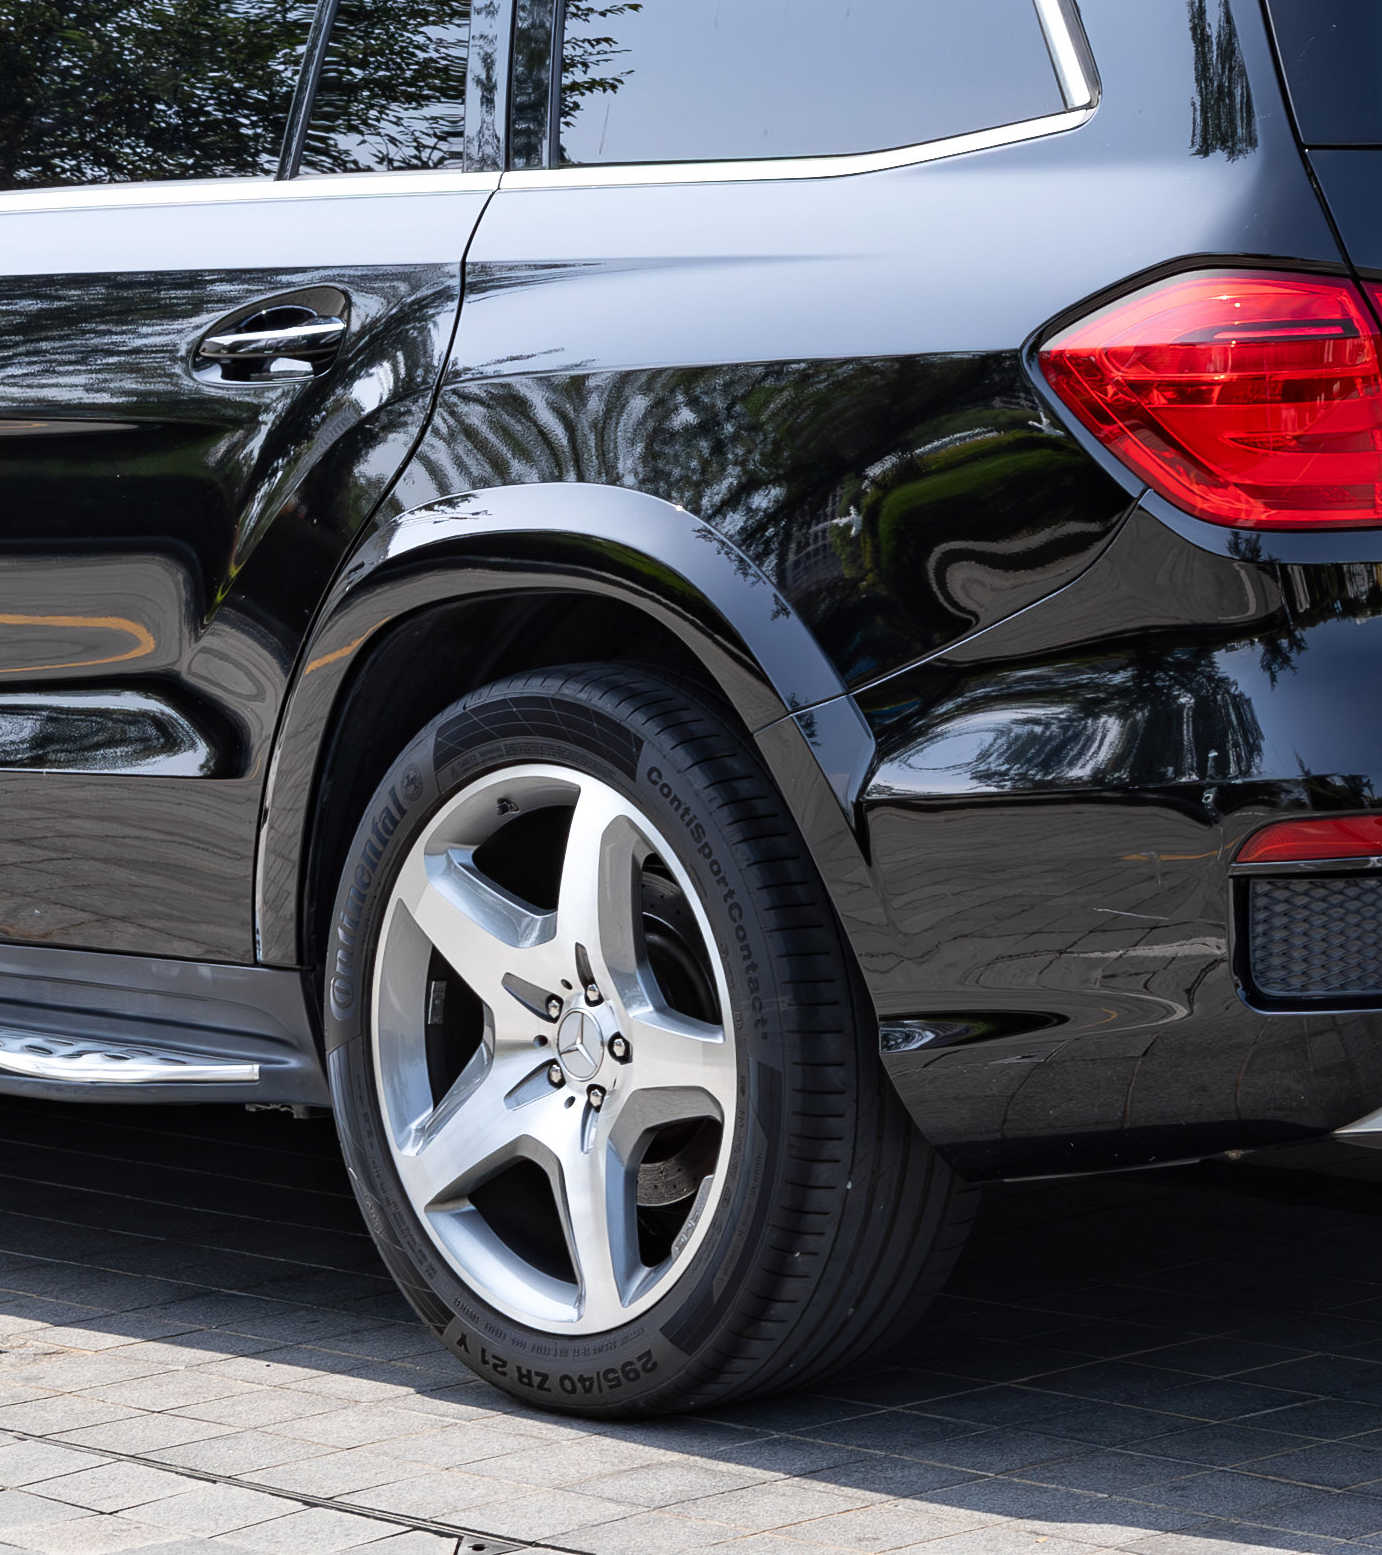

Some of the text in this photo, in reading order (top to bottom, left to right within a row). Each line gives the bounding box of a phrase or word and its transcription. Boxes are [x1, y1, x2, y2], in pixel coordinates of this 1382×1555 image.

[330, 785, 408, 1021] Continental
[479, 1346, 509, 1376] 21
[515, 1364, 553, 1393] ZR
[558, 1348, 658, 1394] 295/40
